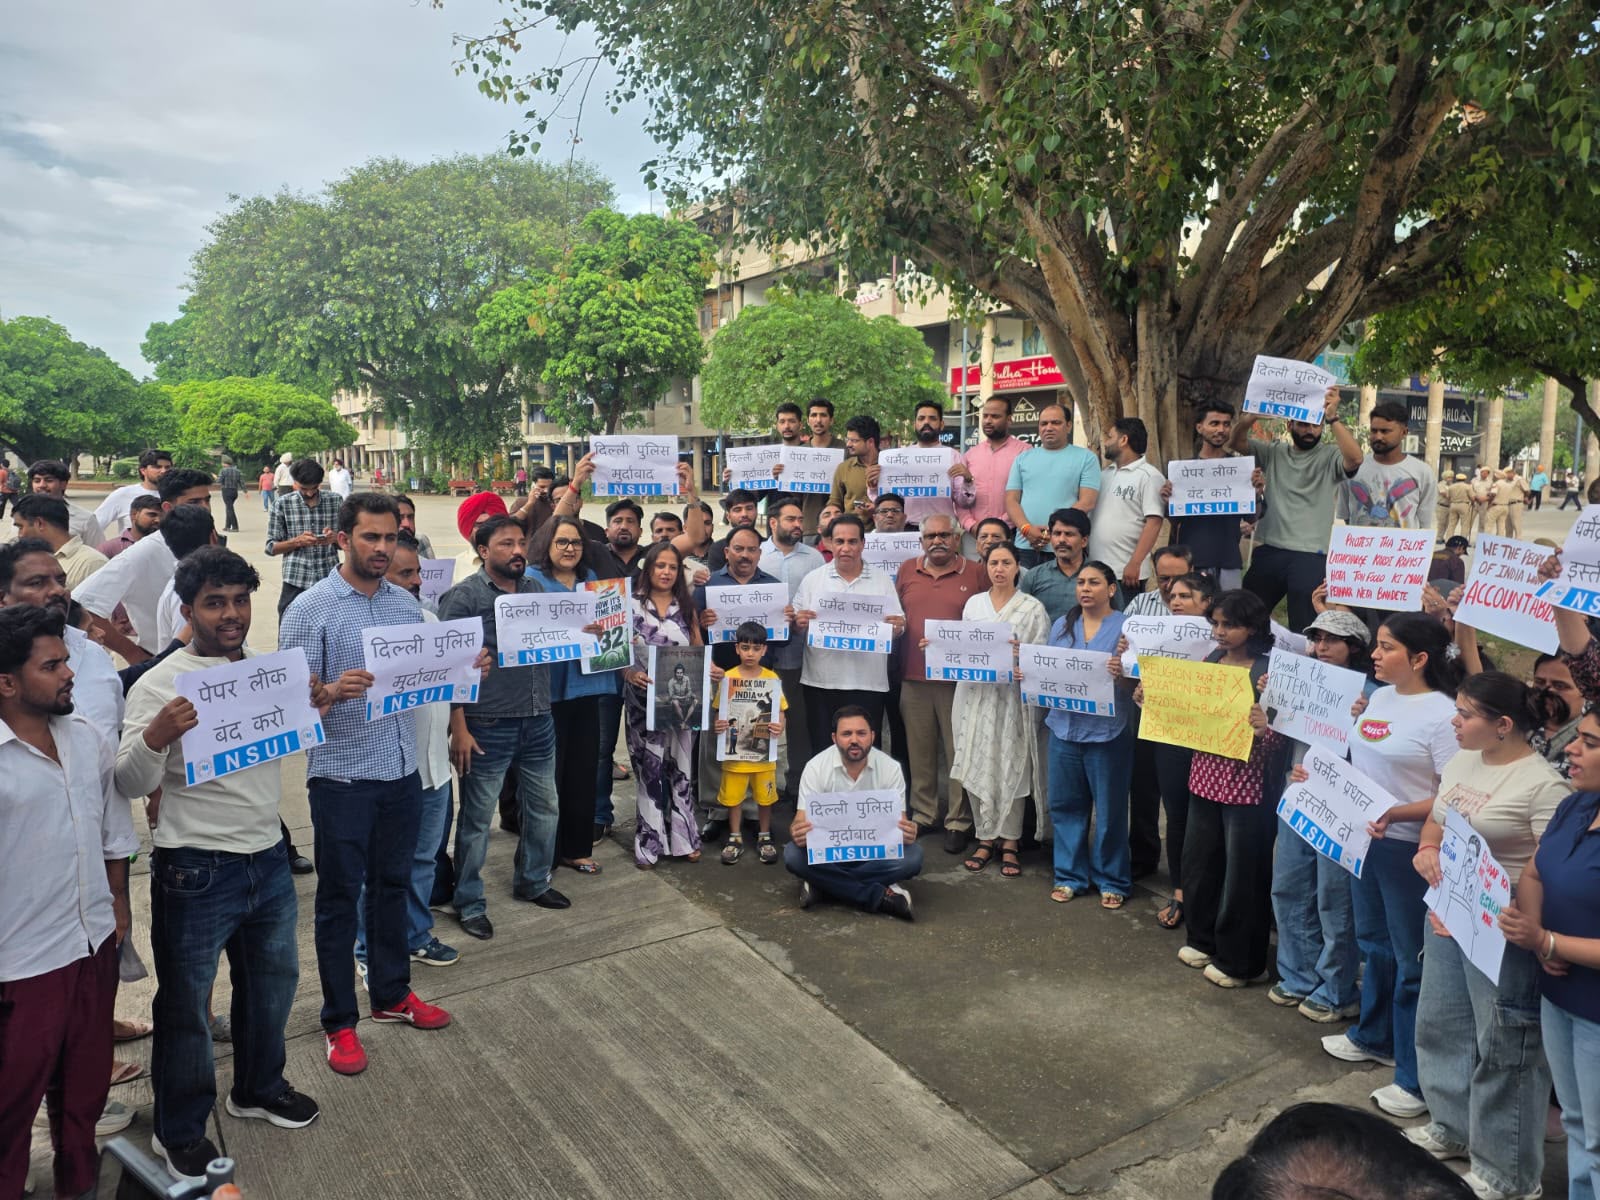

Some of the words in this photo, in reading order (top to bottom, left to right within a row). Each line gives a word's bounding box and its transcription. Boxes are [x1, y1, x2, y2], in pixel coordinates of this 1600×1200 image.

[1256, 362, 1289, 378] दिल्ली
[1295, 369, 1328, 385] पुलिस
[1265, 404, 1304, 420] NSUI
[1411, 405, 1427, 420] MON
[594, 442, 630, 455] दिल्ली
[637, 442, 670, 460] पुलिस
[1181, 466, 1205, 478] पेपर
[1211, 465, 1238, 476] लीक
[614, 484, 656, 495] NSUI
[744, 480, 775, 489] NSUI
[795, 483, 826, 492] NSUI
[898, 487, 931, 497] NSUI
[1211, 485, 1232, 498] करो
[1191, 503, 1232, 514] NSUI
[1345, 533, 1375, 548] PROTEST
[1483, 541, 1499, 556] WE
[1501, 544, 1521, 560] THE
[1478, 561, 1497, 575] OF
[1495, 564, 1524, 583] INDIA
[720, 591, 742, 604] पेपर
[748, 590, 773, 603] लीक
[1571, 592, 1600, 613] NS
[500, 601, 540, 619] दिल्ली
[549, 600, 588, 620] पुलिस
[595, 607, 610, 618] TIME
[611, 603, 622, 612] FOR
[868, 622, 879, 635] दो
[938, 626, 962, 640] पेपर
[969, 627, 995, 640] लीक
[1127, 620, 1165, 634] दिल्ली
[1173, 622, 1213, 641] पुलिस
[371, 634, 424, 658] दिल्ली
[434, 630, 475, 658] पुलिस
[601, 626, 624, 652] 32
[830, 637, 868, 650] NSUI
[525, 646, 575, 663] NSUI
[968, 651, 990, 665] करो
[1033, 652, 1059, 669] पेपर
[1065, 656, 1093, 671] लीक
[949, 669, 989, 681] NSUI
[1142, 662, 1192, 681] RELIGION
[1273, 655, 1300, 676] Break
[1310, 662, 1327, 685] the
[198, 680, 237, 703] पेपर
[248, 668, 286, 691] लीक
[732, 680, 752, 688] BLACK
[754, 680, 766, 689] DAY
[1065, 682, 1088, 696] करो
[1142, 677, 1192, 696] EDUCATION
[1269, 670, 1311, 698] PATTERN
[1317, 684, 1344, 709] TODAY
[391, 688, 444, 711] NSUI
[735, 691, 757, 699] INDIA
[1045, 696, 1089, 711] NSUI
[1200, 703, 1233, 719] BLACK
[252, 705, 284, 731] करो
[1144, 706, 1162, 721] FOR
[1303, 715, 1347, 743] TOMORROW
[1363, 724, 1388, 735] JUICY
[225, 735, 290, 770] NSUI
[810, 800, 848, 816] दिल्ली
[856, 797, 894, 819] पुलिस
[1294, 815, 1336, 857] NSUI
[1337, 822, 1353, 842] दो
[832, 847, 878, 860] NSUI
